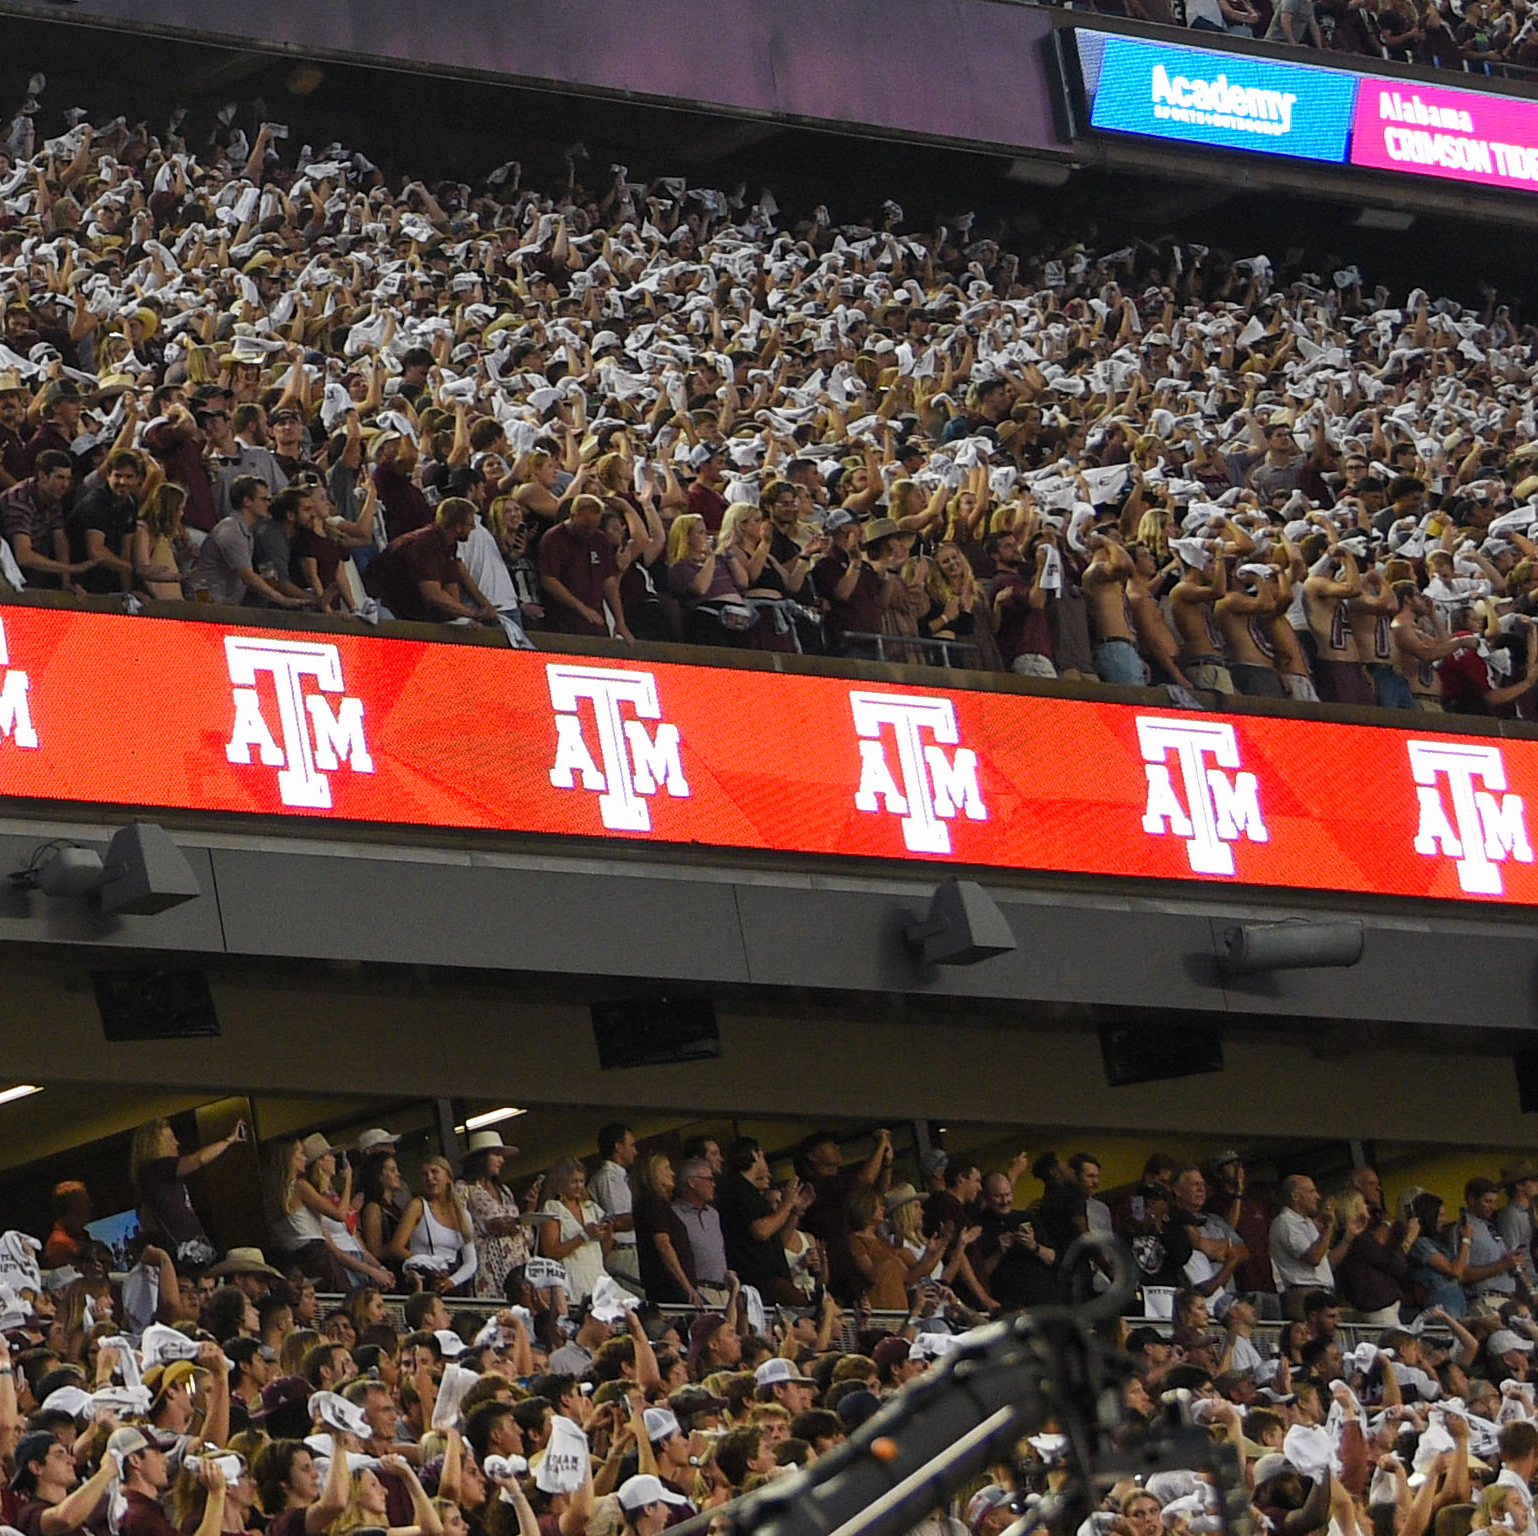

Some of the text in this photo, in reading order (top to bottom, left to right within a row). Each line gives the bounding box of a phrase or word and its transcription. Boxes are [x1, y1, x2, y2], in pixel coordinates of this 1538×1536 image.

[1150, 64, 1298, 135] Academy
[1379, 91, 1474, 133] Alabama
[1384, 126, 1492, 174] CRIMSON
[546, 1268, 566, 1280] MAN
